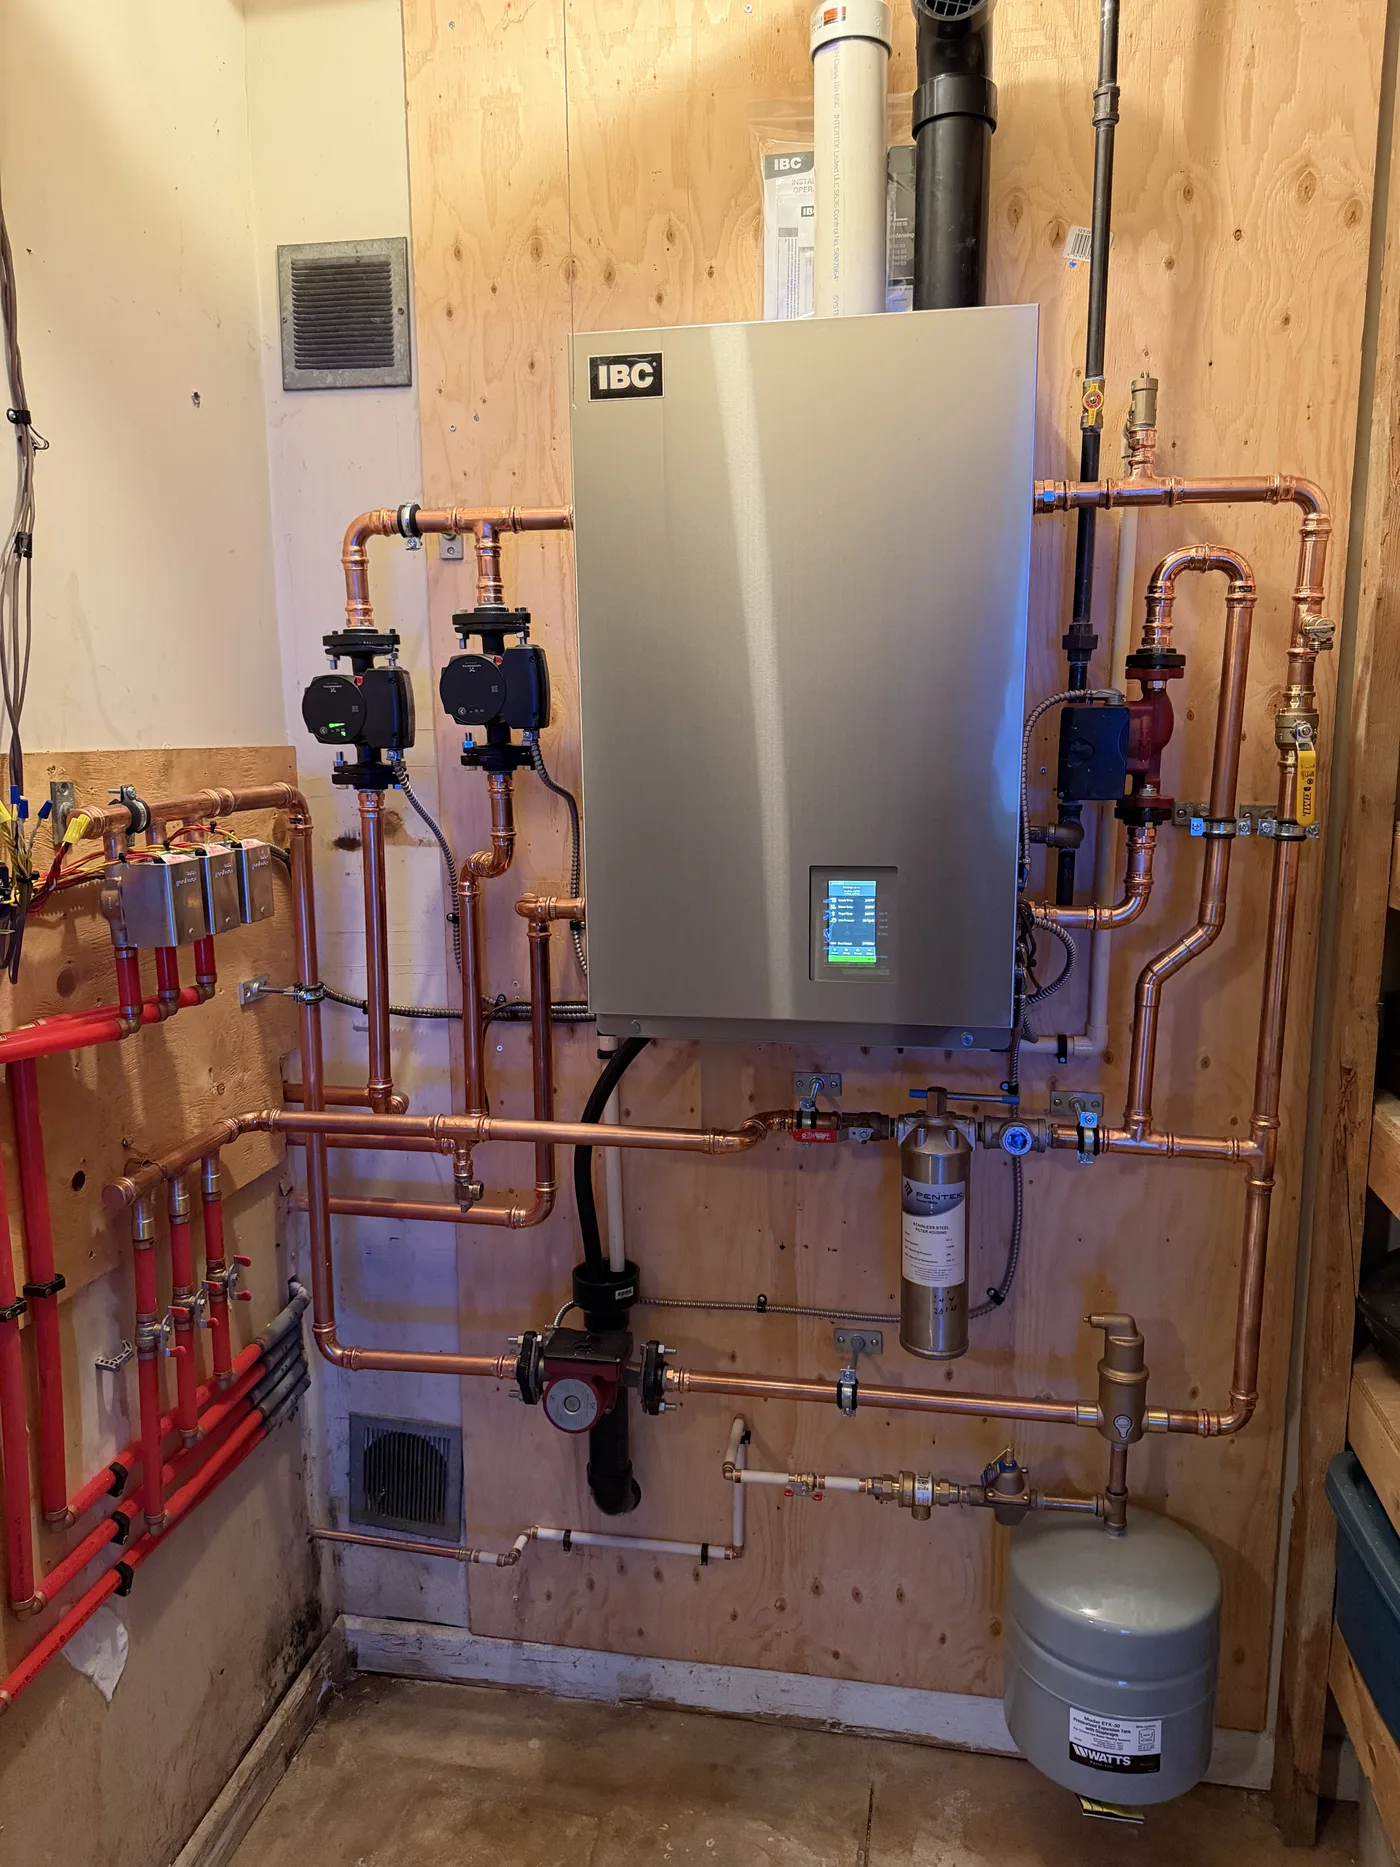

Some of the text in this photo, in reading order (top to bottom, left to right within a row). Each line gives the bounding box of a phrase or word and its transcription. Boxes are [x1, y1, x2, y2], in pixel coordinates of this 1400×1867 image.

[774, 157, 802, 170] IBC
[803, 207, 814, 216] IB
[598, 362, 654, 390] IBC
[916, 1191, 964, 1201] PENTEK
[913, 1222, 935, 1230] STAINLESS
[1073, 1717, 1097, 1728] Pressurized
[1098, 1725, 1120, 1733] Expansion
[1084, 1716, 1121, 1729] Model ETX-30
[1087, 1748, 1131, 1766] WATTS
